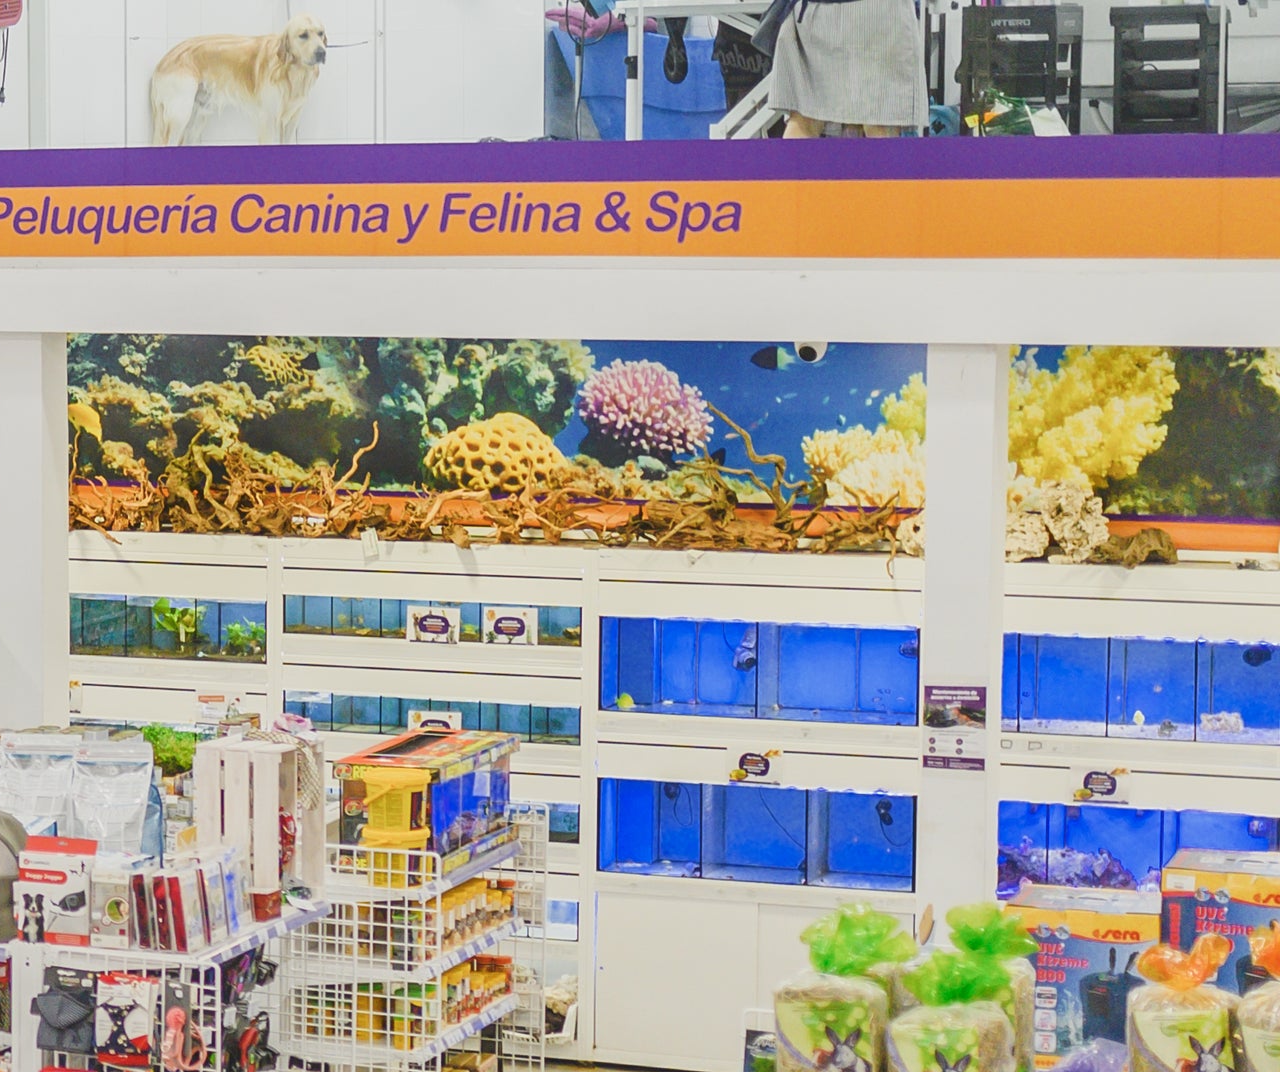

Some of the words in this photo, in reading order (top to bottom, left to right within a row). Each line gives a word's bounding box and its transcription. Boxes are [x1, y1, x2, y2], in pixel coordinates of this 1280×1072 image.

[230, 193, 389, 234] Canina
[397, 203, 429, 243] y
[439, 192, 581, 233] Felina
[595, 191, 632, 233] &
[645, 190, 742, 243] Spa
[1195, 907, 1227, 921] UVC
[1101, 928, 1140, 941] sera
[1195, 920, 1256, 936] Xtreme
[1036, 955, 1089, 969] Xtreme
